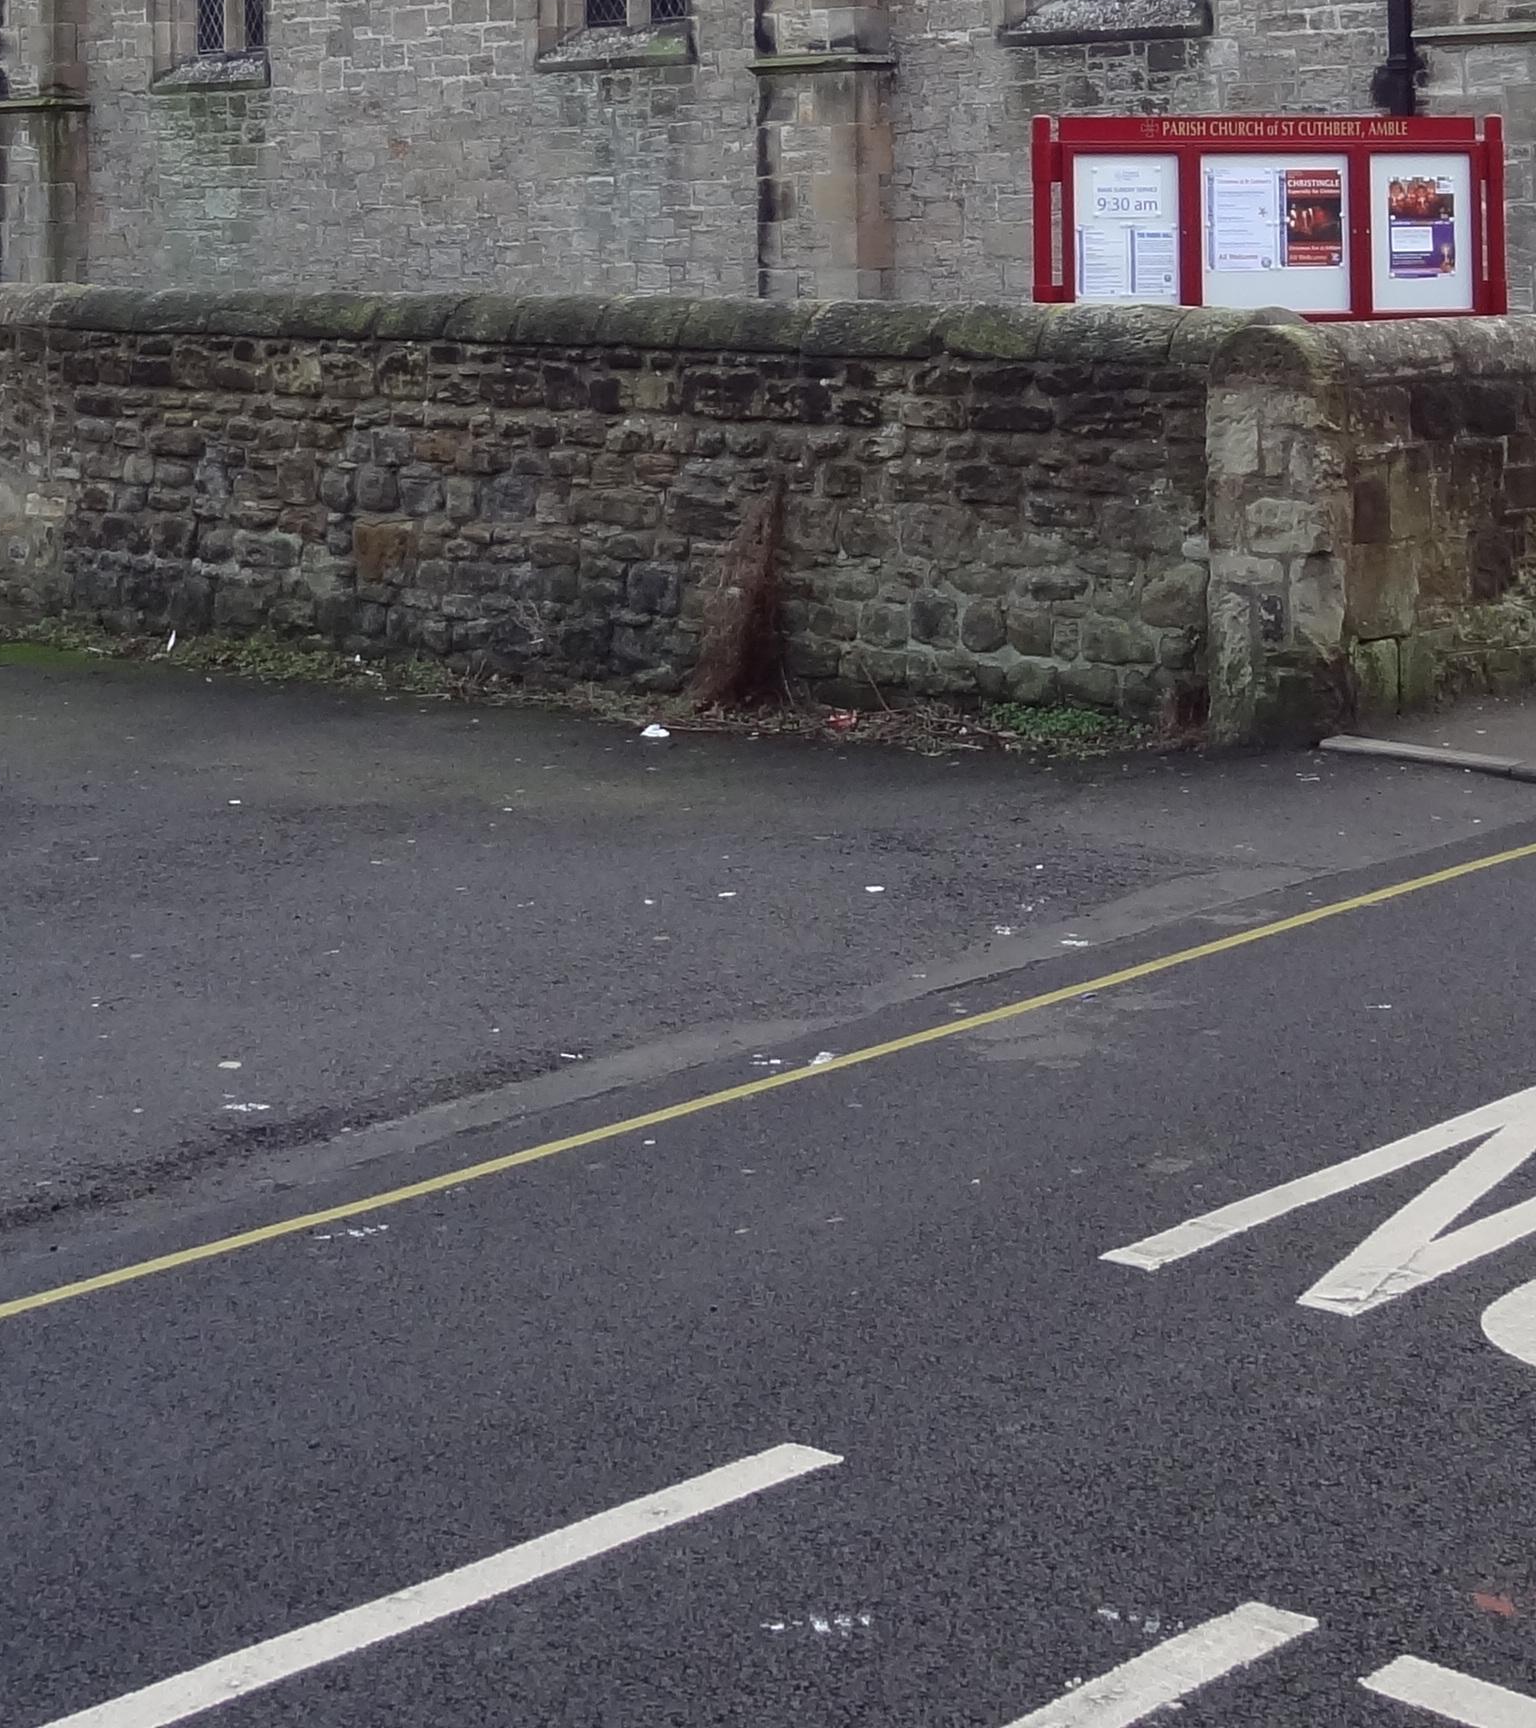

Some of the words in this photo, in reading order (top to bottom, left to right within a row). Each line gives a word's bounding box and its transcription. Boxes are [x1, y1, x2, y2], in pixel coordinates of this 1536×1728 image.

[1162, 121, 1206, 136] PARISH
[1210, 121, 1264, 136] CHURCH
[1267, 121, 1279, 136] of
[1281, 121, 1295, 136] ST
[1298, 121, 1365, 138] CUTHBERT,
[1368, 121, 1408, 136] AMBLE
[1287, 179, 1340, 188] CHRISTINGLE
[1097, 197, 1130, 211] 9:30
[1134, 200, 1158, 211] am
